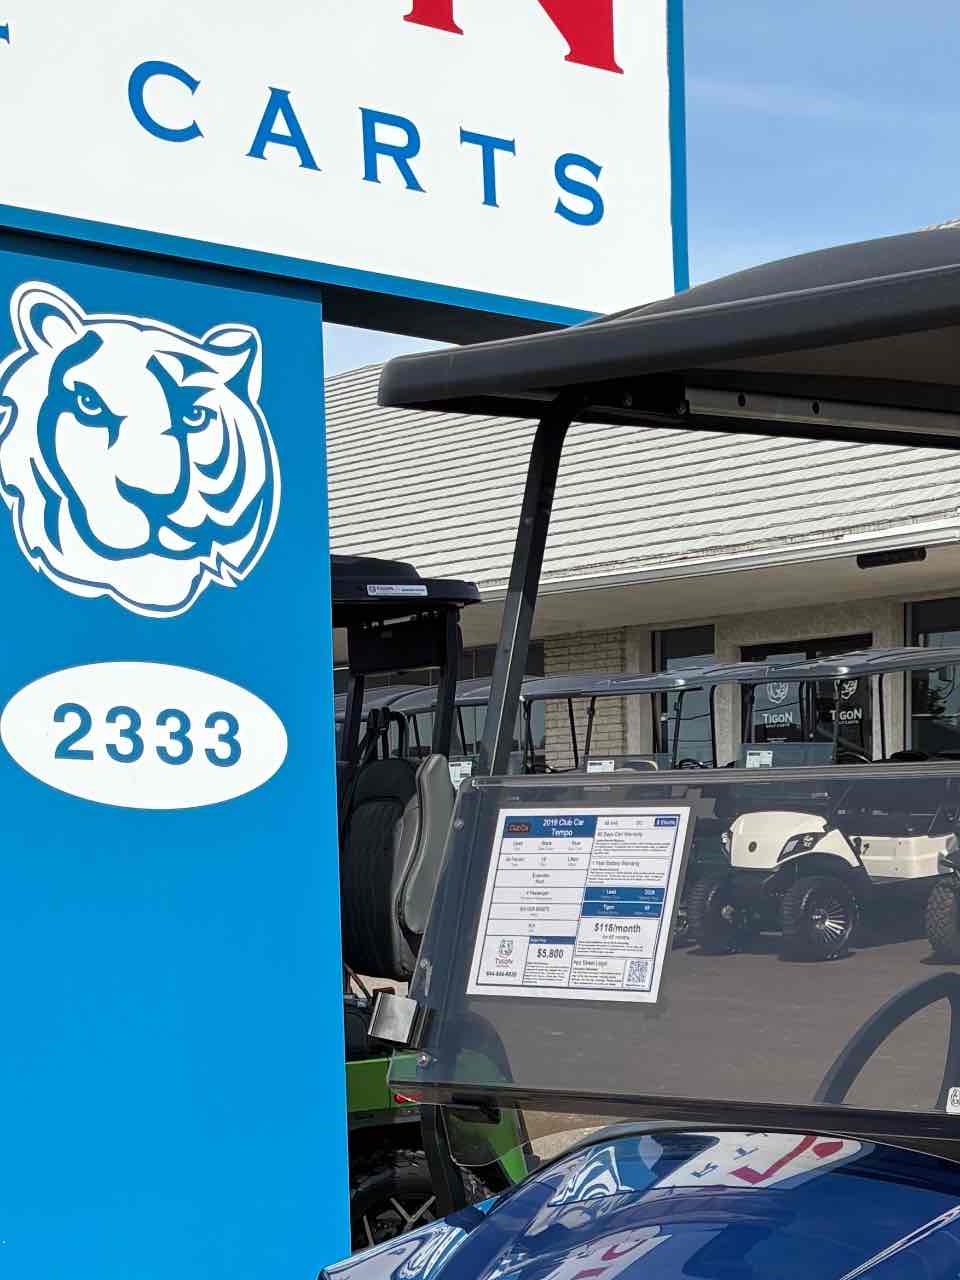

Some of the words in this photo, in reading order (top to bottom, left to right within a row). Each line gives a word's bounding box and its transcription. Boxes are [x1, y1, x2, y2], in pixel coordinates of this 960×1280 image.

[127, 60, 605, 227] CARTS
[762, 712, 793, 723] TIGON
[830, 708, 862, 720] TGON
[53, 702, 242, 768] 2333
